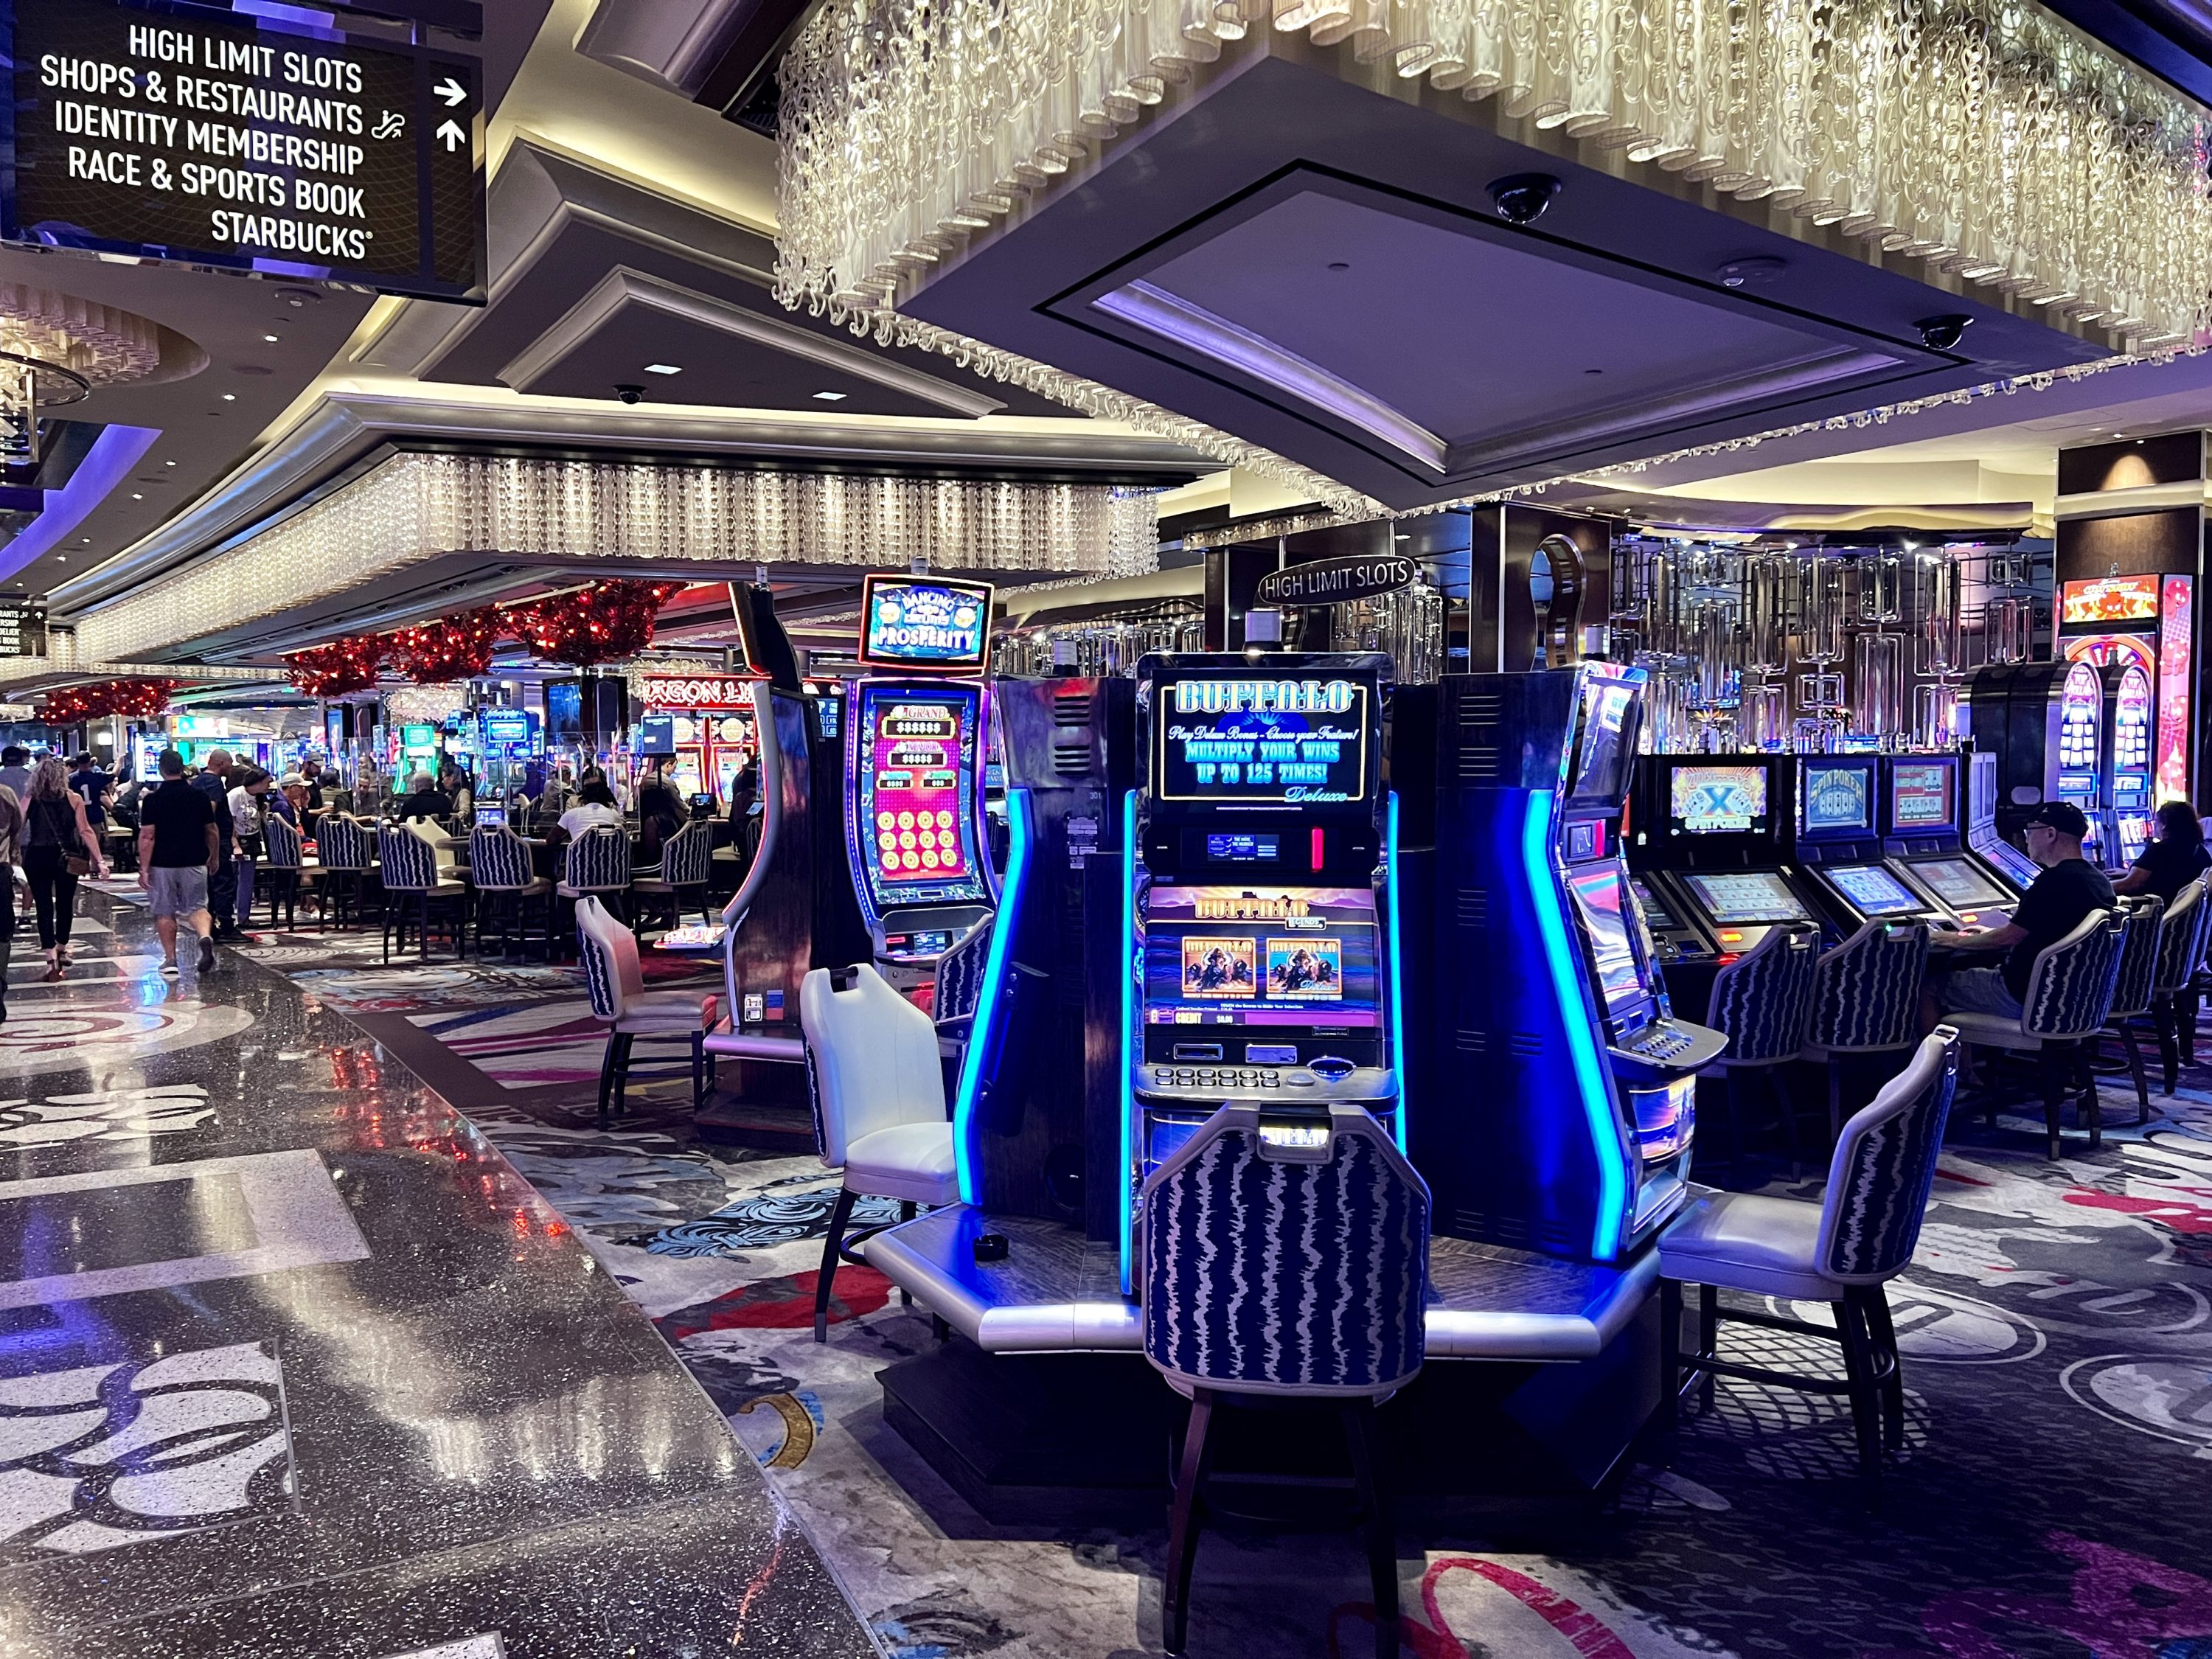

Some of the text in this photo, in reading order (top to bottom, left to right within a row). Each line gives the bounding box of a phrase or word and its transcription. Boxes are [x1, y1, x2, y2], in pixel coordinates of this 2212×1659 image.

[129, 24, 363, 93] HIGH LIMIT SLOTS
[41, 55, 363, 136] SHOPS & RESTAURANTS
[55, 100, 364, 175] IDENTITY MEMBERSHIP
[69, 146, 366, 219] RACE & SPORTS BOOK
[1265, 560, 1408, 598] HIGH LIMIT SLOTS
[901, 591, 956, 612] DANCING
[2, 636, 20, 644] BOOK
[877, 626, 975, 650] PROSPERITY
[1175, 681, 1355, 714] BUFFALO
[908, 707, 946, 718] GRAND
[1169, 726, 1194, 743] Play
[1185, 741, 1340, 762] MULTIPLY YOUR WINS
[1196, 763, 1328, 784] UP TO 125 TIMES!
[1284, 786, 1349, 803] Deluxe
[1810, 770, 1832, 804] SPIN
[1833, 769, 1863, 804] POKER
[1700, 786, 1739, 818] X
[1195, 899, 1310, 918] BUFFALO
[1175, 1012, 1202, 1024] CREDIT
